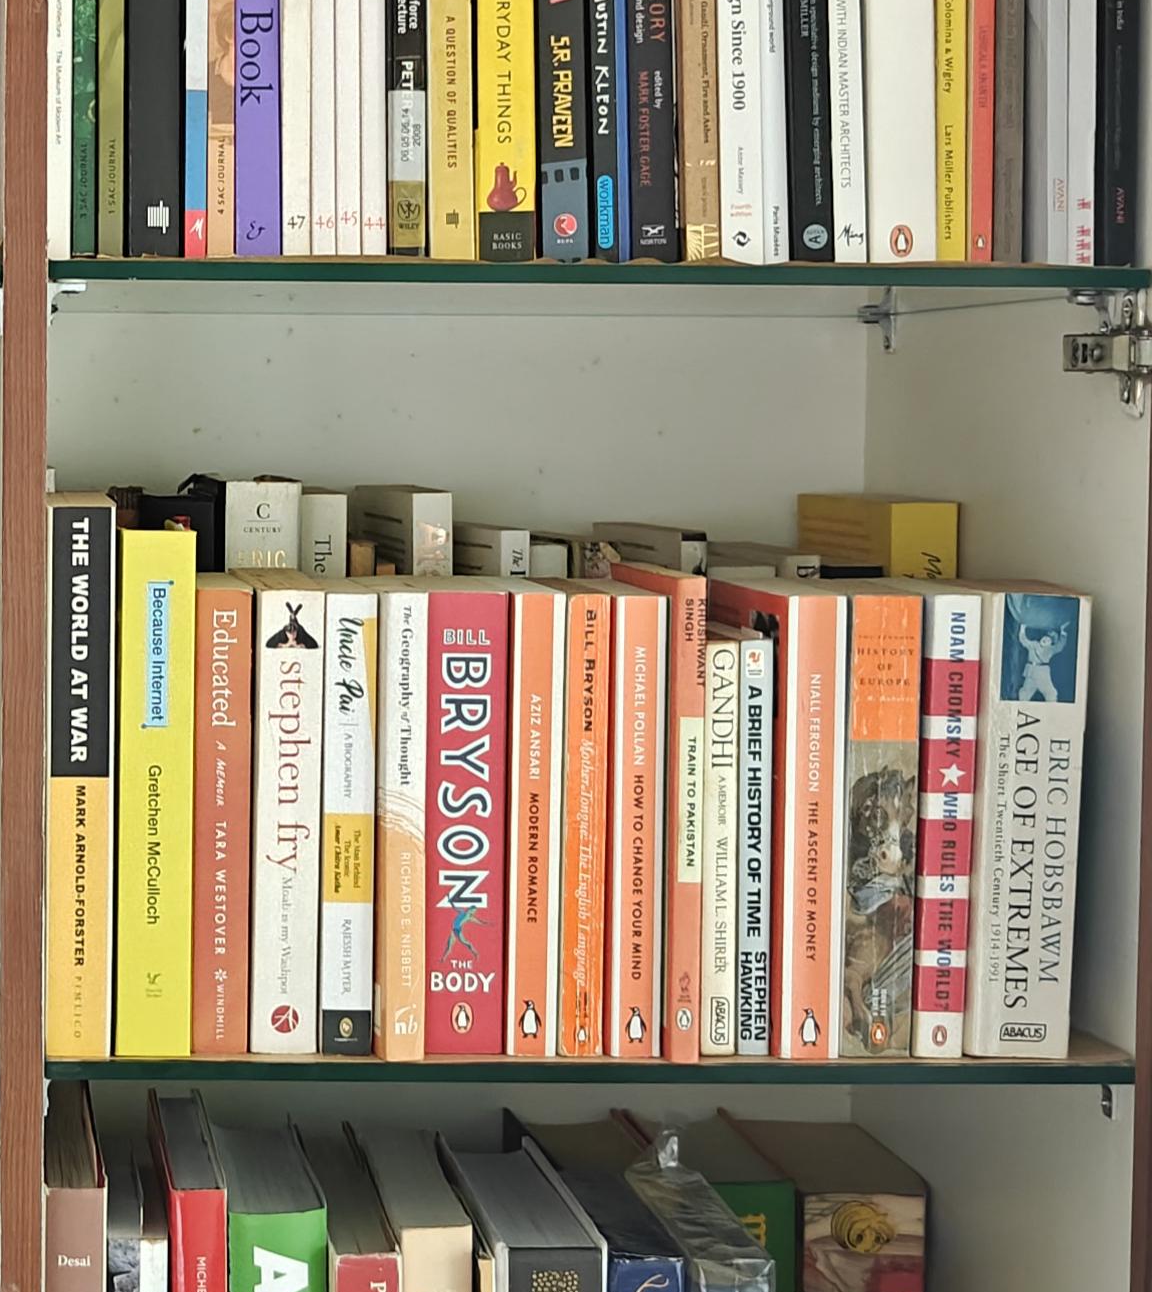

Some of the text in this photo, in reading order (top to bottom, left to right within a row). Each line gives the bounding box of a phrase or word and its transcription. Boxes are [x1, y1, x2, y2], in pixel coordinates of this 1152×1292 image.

[239, 8, 273, 107] Book
[730, 21, 747, 65] Since
[730, 71, 747, 110] 1900
[598, 179, 612, 246] workman
[70, 517, 90, 762] THE WORLD AT WAR
[150, 587, 166, 721] Because Internet
[211, 608, 236, 727] Educated
[266, 660, 312, 873] stephen fry
[436, 653, 492, 909] BRYSON
[526, 694, 542, 923] AZIZ ANSARI MODERN ROMANCE
[146, 765, 163, 924] Gretchen McCulloch
[1038, 738, 1071, 984] ERIC HOBSBAWM
[739, 951, 753, 1041] HAWKING
[753, 951, 766, 1041] STEPHEN
